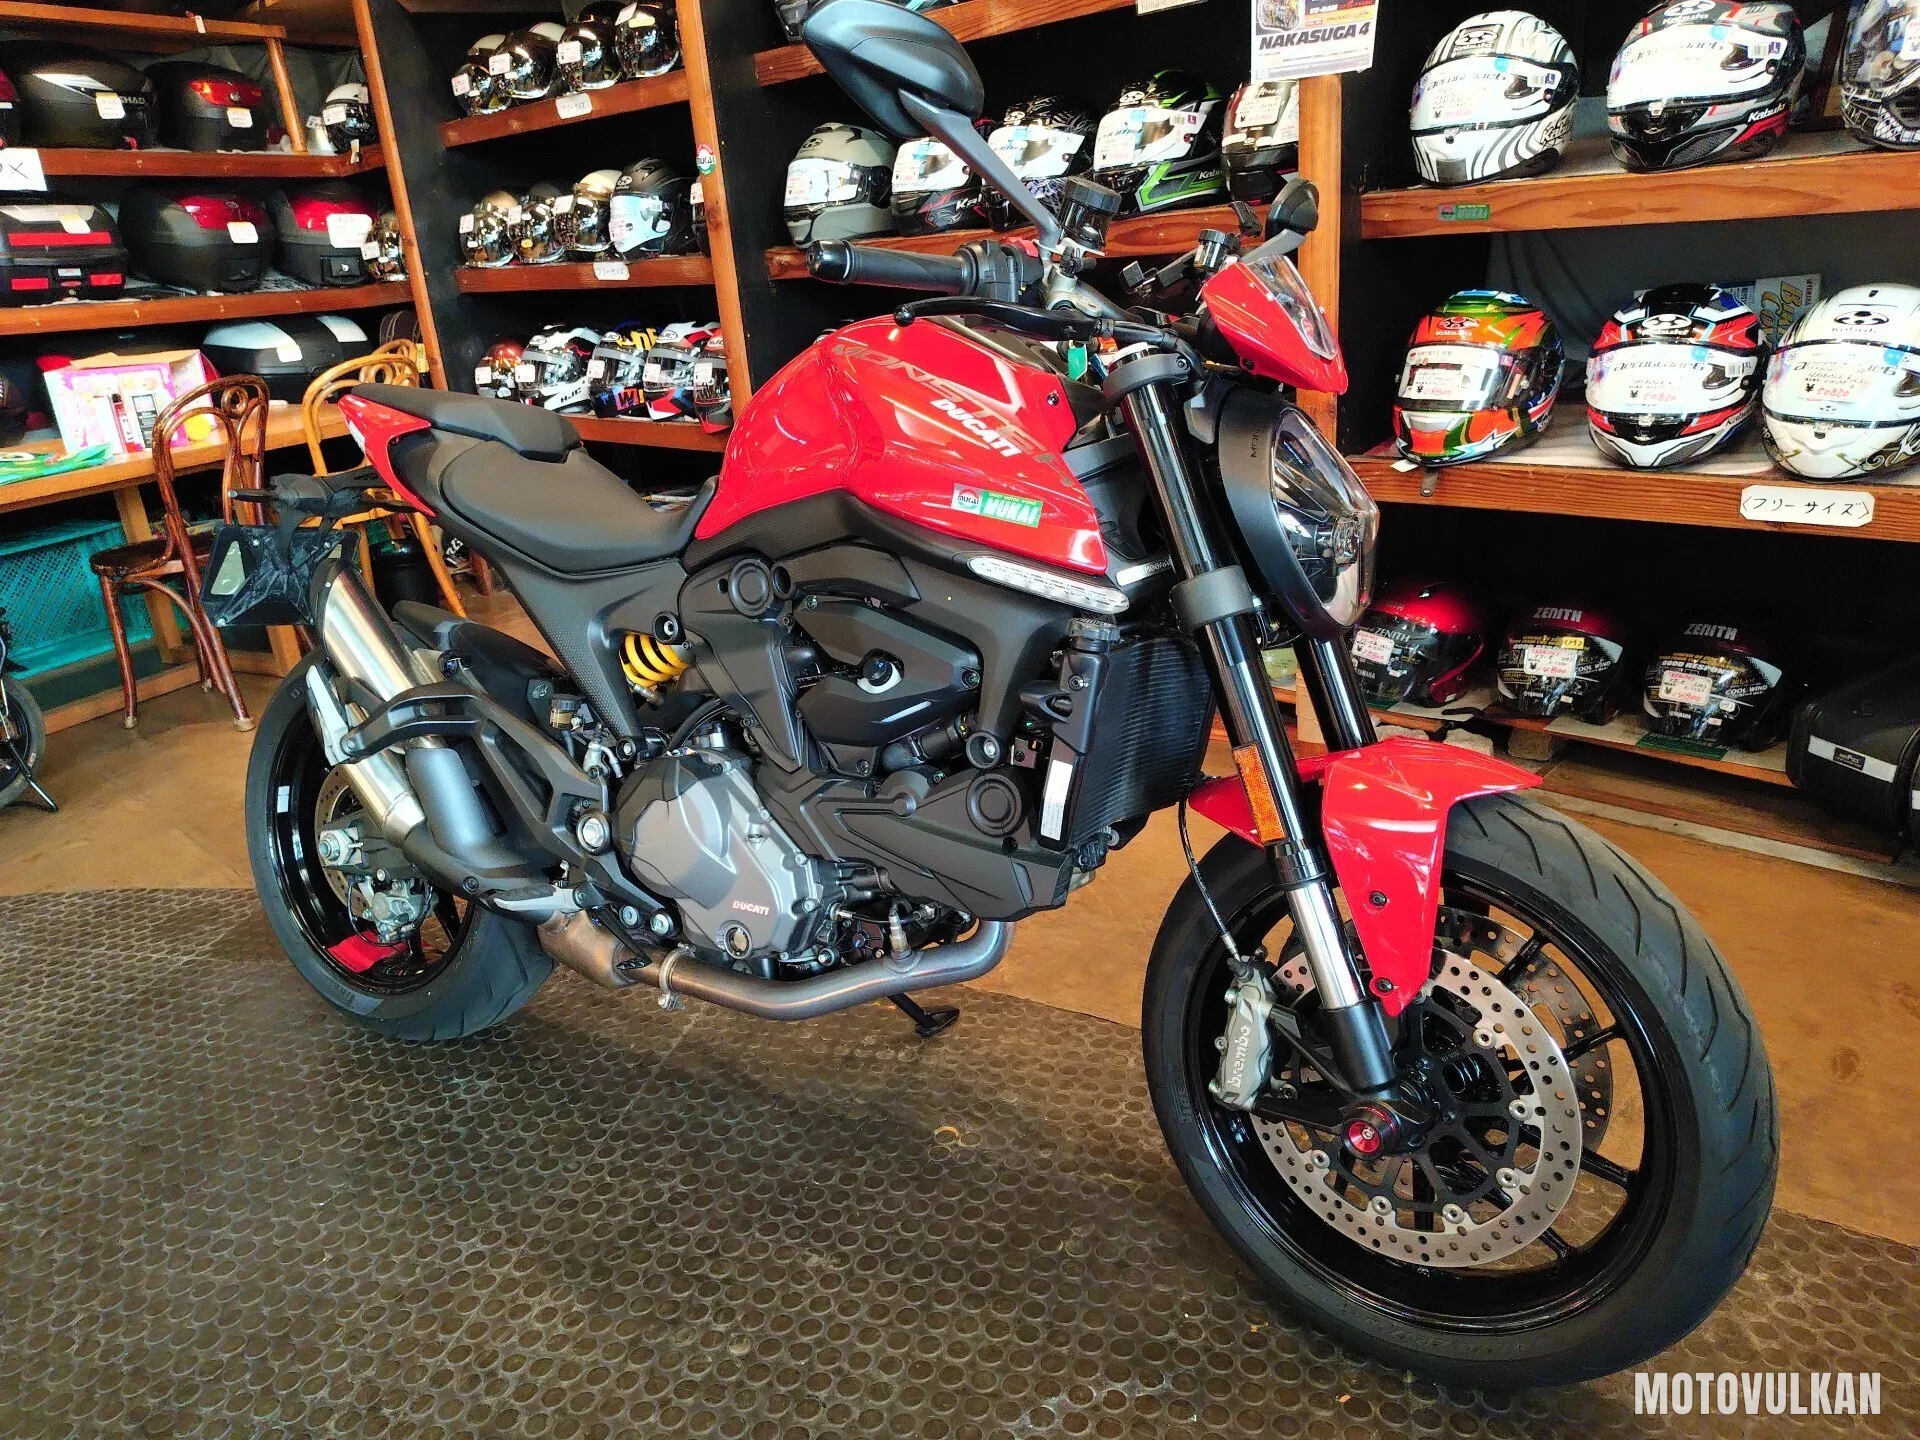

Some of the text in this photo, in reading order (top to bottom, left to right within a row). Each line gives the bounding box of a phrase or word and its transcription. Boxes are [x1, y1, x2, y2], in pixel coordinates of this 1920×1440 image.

[1662, 13, 1709, 24] Kabuto
[1259, 21, 1371, 50] NAKASUGA 4
[1747, 102, 1786, 123] Kabuto
[560, 387, 583, 403] HJC
[930, 398, 1023, 458] DUCATI
[982, 497, 1040, 525] MUKAI
[1533, 607, 1583, 622] ZENITH
[1374, 627, 1411, 643] ZENITH
[1684, 623, 1738, 640] ZENITH
[1661, 659, 1684, 667] GOOD
[1725, 684, 1769, 697] COOL WIND
[732, 900, 769, 916] DUCATI
[1228, 1025, 1250, 1089] brembo
